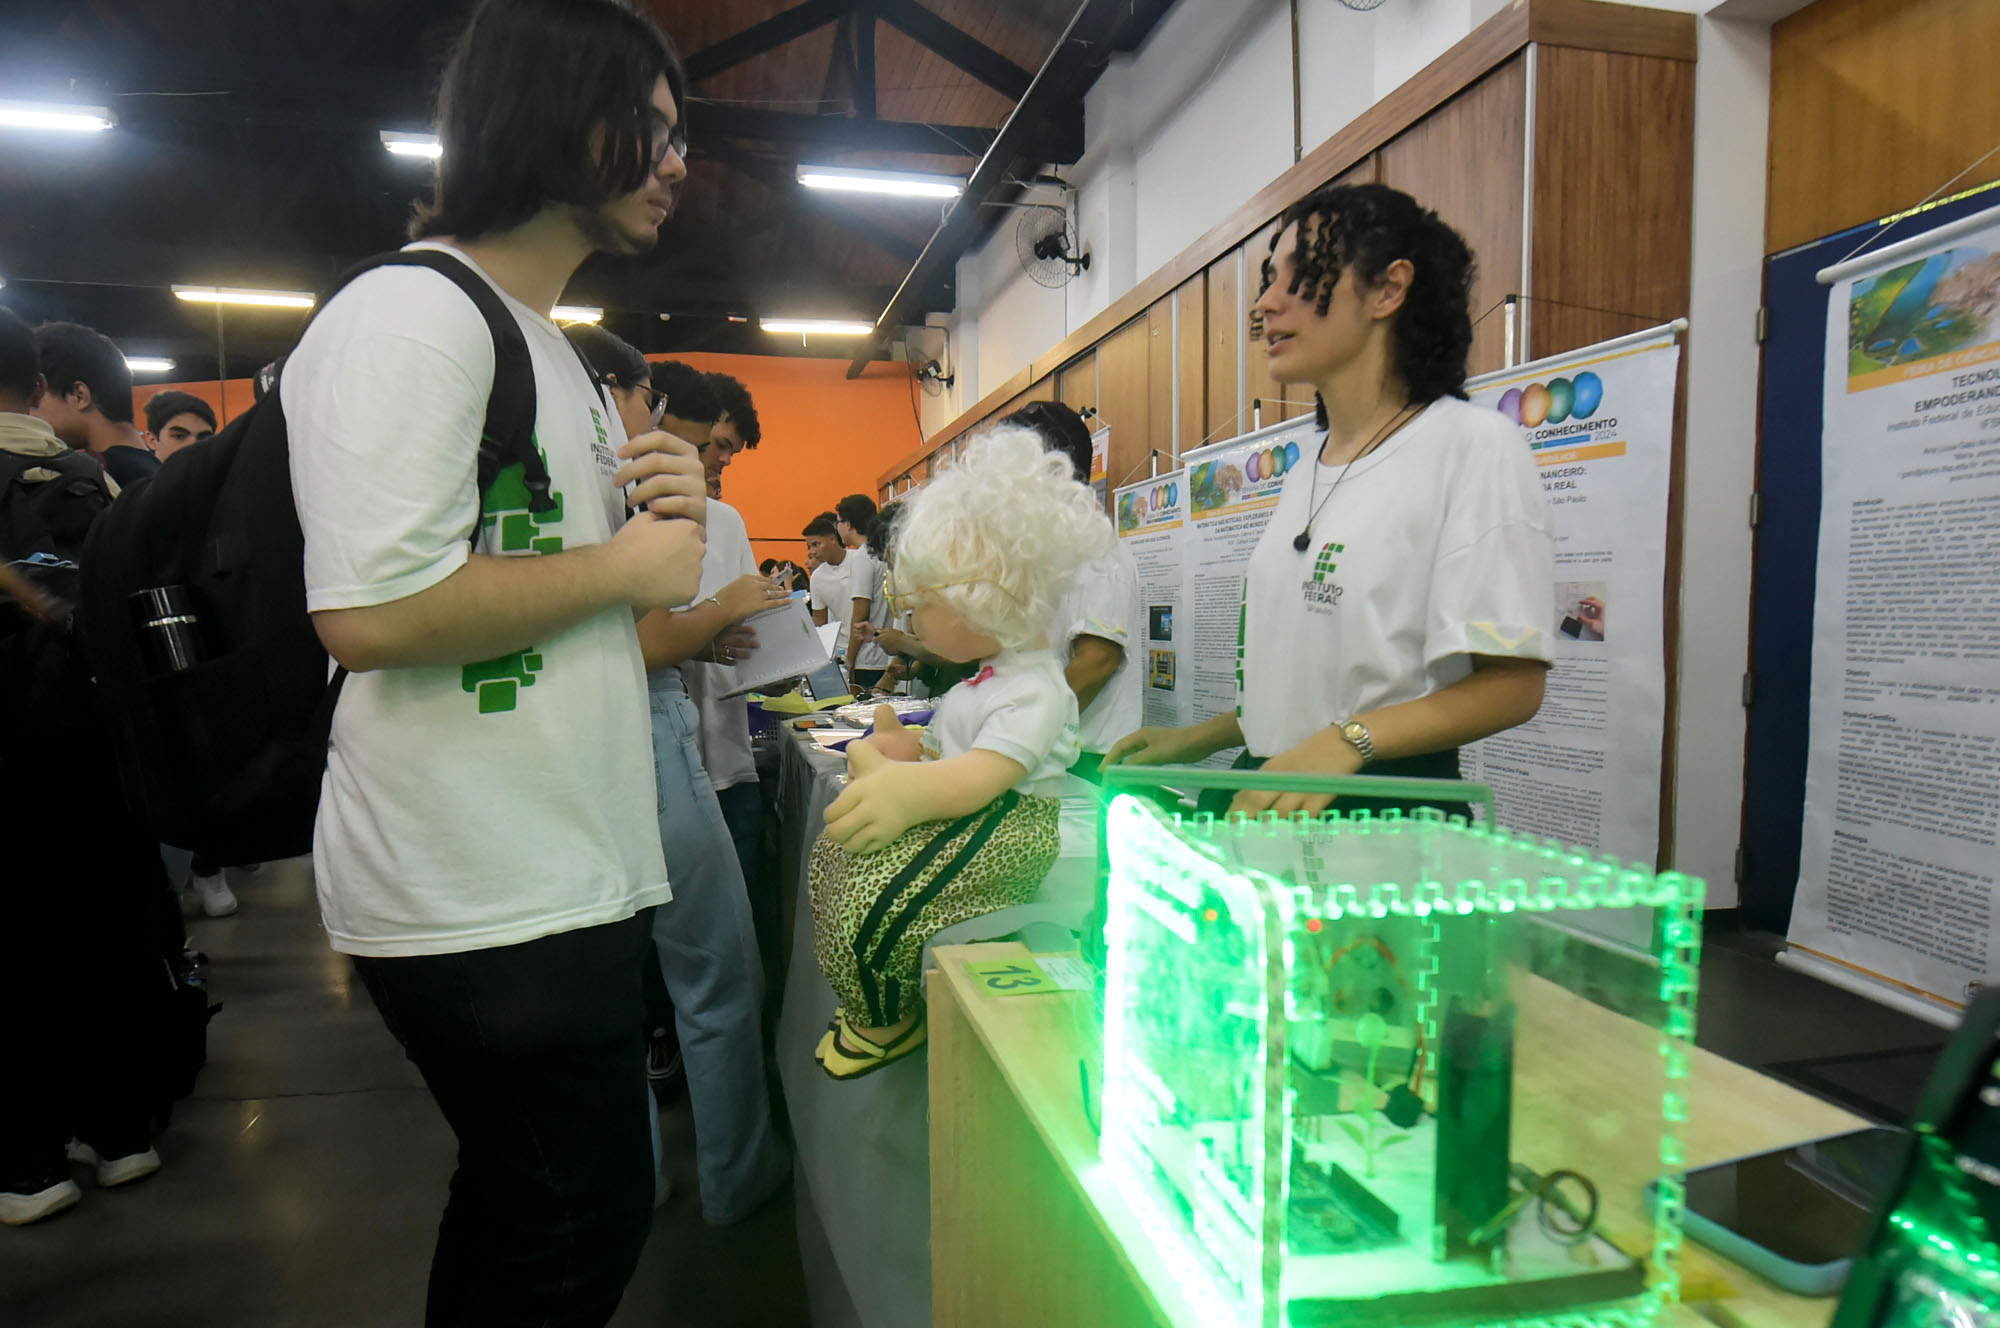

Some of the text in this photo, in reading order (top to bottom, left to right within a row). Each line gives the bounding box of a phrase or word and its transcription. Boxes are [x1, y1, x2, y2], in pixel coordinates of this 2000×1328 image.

[1535, 417, 1618, 440] CONHECIMENTO
[1594, 429, 1618, 441] 2024
[1554, 480, 1577, 490] REAL
[979, 965, 1041, 990] 13
